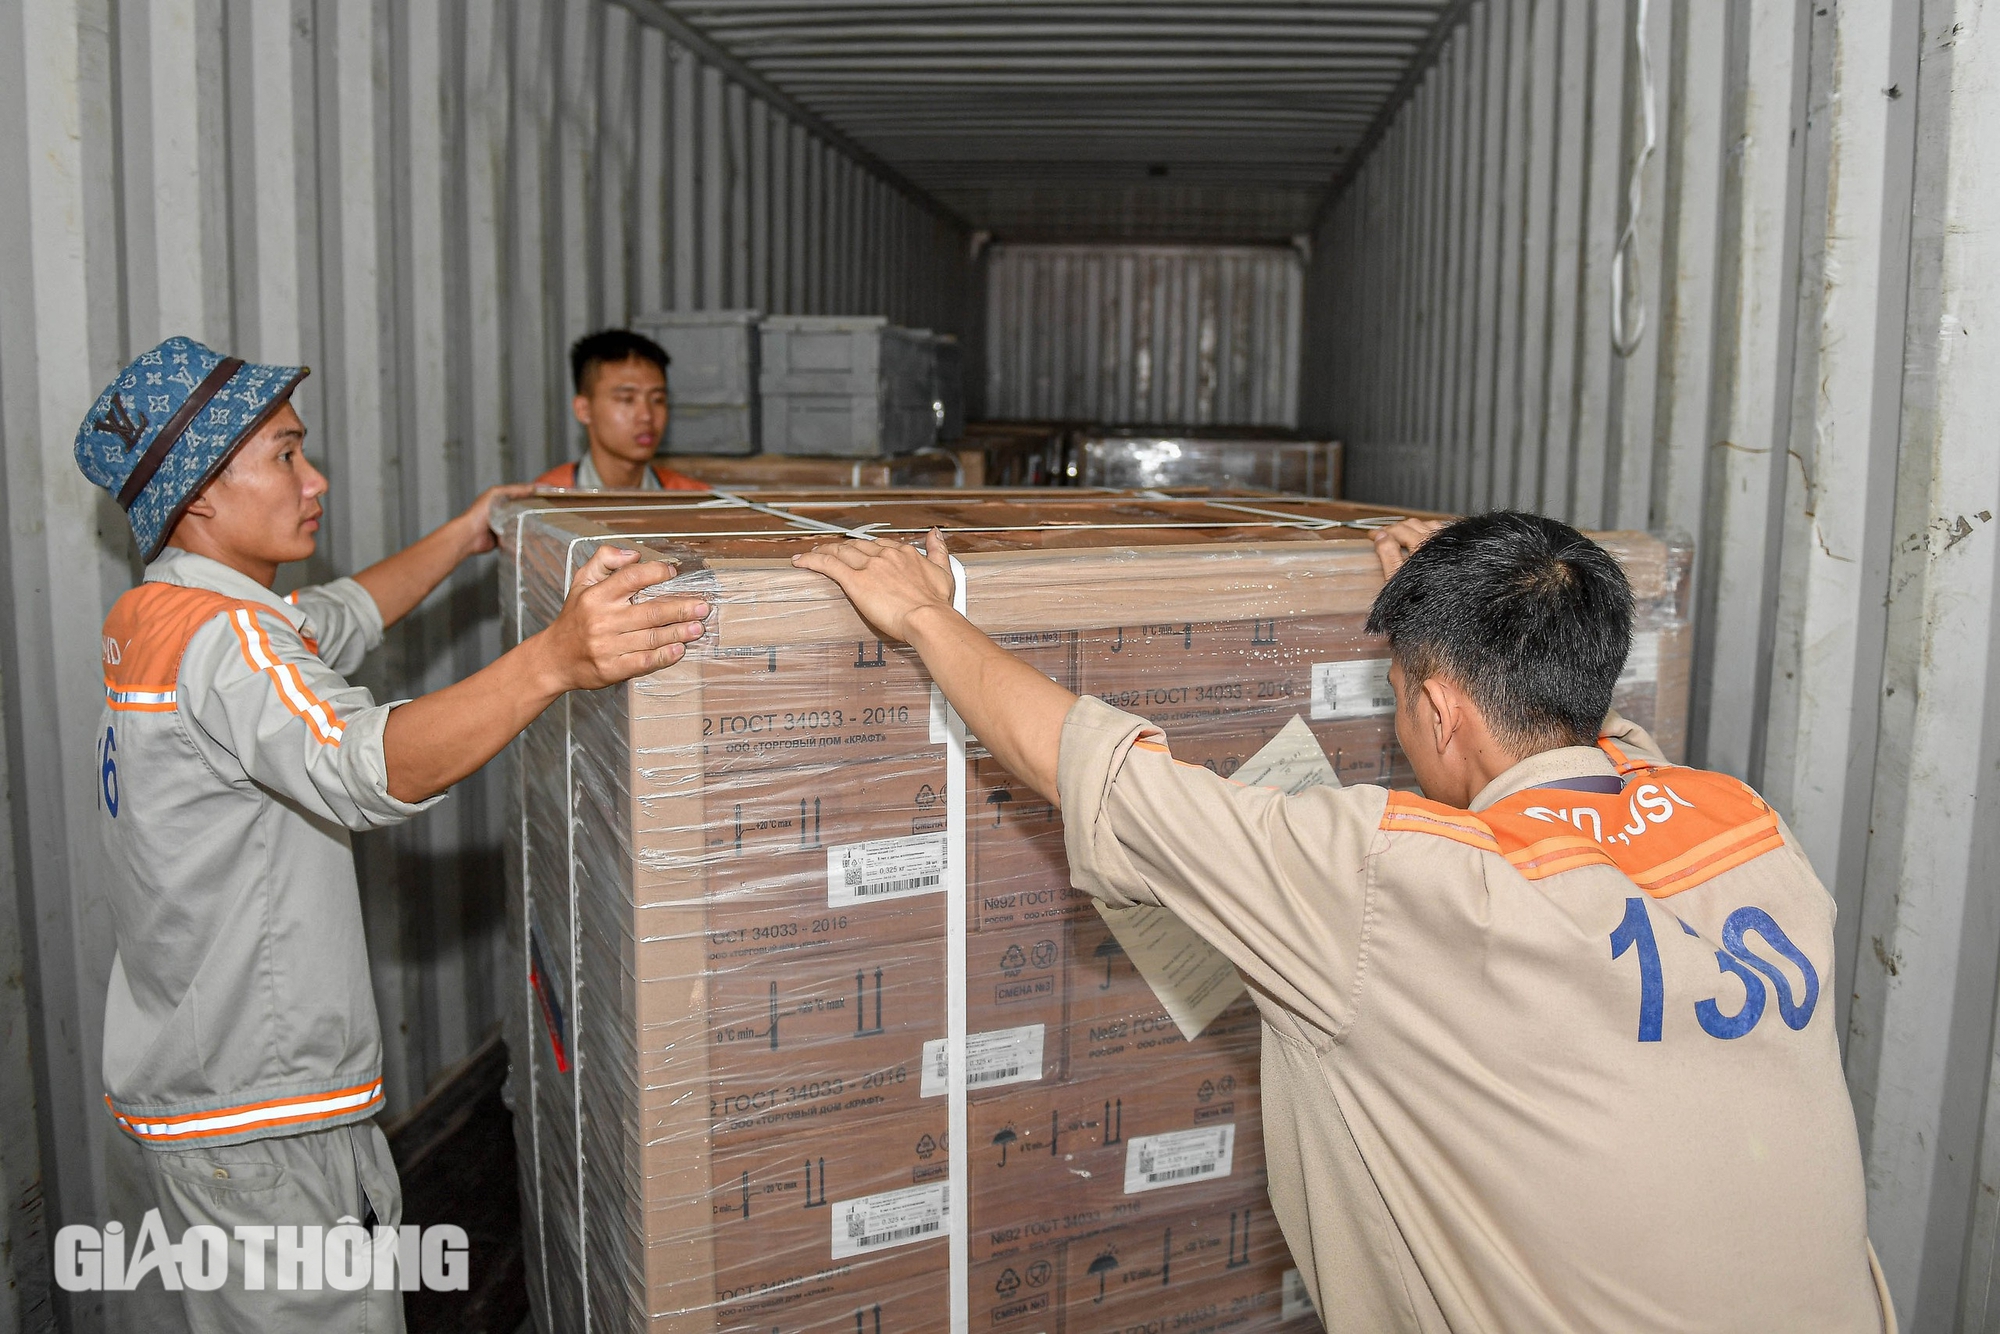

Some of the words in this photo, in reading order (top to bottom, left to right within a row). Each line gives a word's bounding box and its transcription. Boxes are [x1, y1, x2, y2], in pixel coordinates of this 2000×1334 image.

[1144, 687, 1189, 705] ГОСТ
[1195, 683, 1243, 701] 34033
[720, 713, 778, 735] ГОСТ
[783, 709, 844, 731] 34033
[862, 705, 909, 726] 2016
[725, 742, 750, 754] ООО
[819, 736, 842, 748] ДОМ
[97, 725, 119, 819] 6
[777, 820, 792, 829] max
[984, 896, 1016, 911] №92
[1020, 890, 1055, 907] ГОСТ
[752, 922, 798, 941] 34033
[812, 916, 848, 933] 2016
[998, 984, 1033, 999] СМЕНА
[737, 1027, 755, 1040] min
[724, 1089, 780, 1114] ГОСТ
[785, 1078, 844, 1103] 34033
[862, 1066, 906, 1090] 2016
